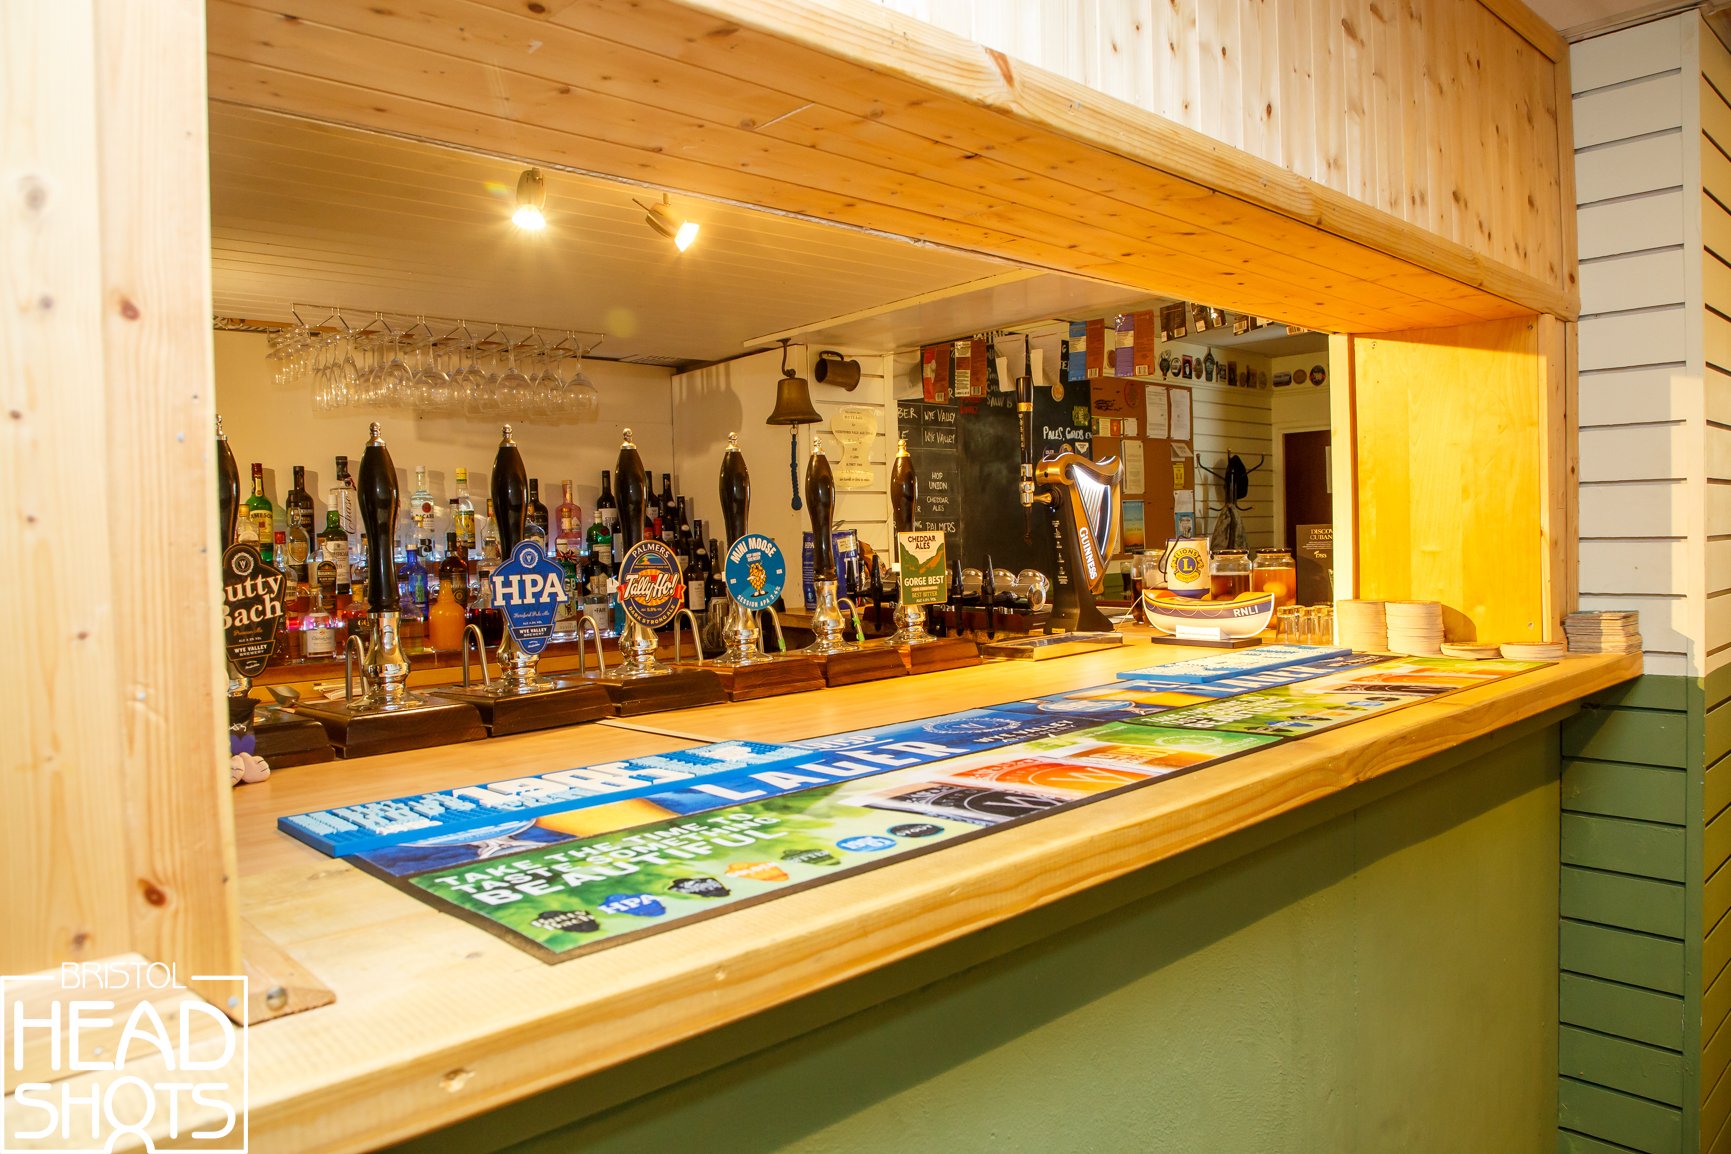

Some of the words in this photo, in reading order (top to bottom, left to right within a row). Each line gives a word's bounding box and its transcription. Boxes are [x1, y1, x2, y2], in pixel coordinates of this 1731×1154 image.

[924, 411, 935, 421] WYE
[937, 409, 956, 425] VALLEY
[925, 431, 935, 442] WYE
[936, 431, 955, 444] VALLEY
[931, 472, 943, 481] HOP
[929, 481, 947, 490] UNION
[932, 504, 944, 512] ALES
[926, 521, 956, 533] PALMERS
[908, 535, 936, 543] CHEDDAR
[915, 542, 930, 550] ALES
[632, 543, 670, 558] PALMERS
[730, 541, 748, 564] MINI
[748, 537, 776, 558] MOOSE
[1080, 527, 1097, 580] GUINNESS
[1176, 549, 1198, 557] LIONS
[1183, 558, 1193, 571] L
[222, 574, 283, 602] utty
[904, 577, 926, 587] GORGE
[928, 576, 944, 585] BEST
[492, 572, 568, 607] HPA
[737, 594, 758, 608] SESSION
[760, 598, 770, 607] APA
[628, 605, 641, 621] DARK
[642, 615, 667, 625] STRONG
[667, 604, 676, 616] ALE
[1233, 605, 1258, 618] RNLI
[247, 644, 267, 652] VALLEY
[690, 741, 971, 801] LAGER
[434, 859, 542, 886] TAKE
[544, 842, 614, 863] THE
[622, 822, 709, 844] TIME
[708, 813, 753, 825] TO
[451, 862, 581, 894] TASTE
[586, 817, 781, 866] SOMETHING
[472, 829, 788, 905] BEAUTIFUL
[598, 893, 660, 914] HPA
